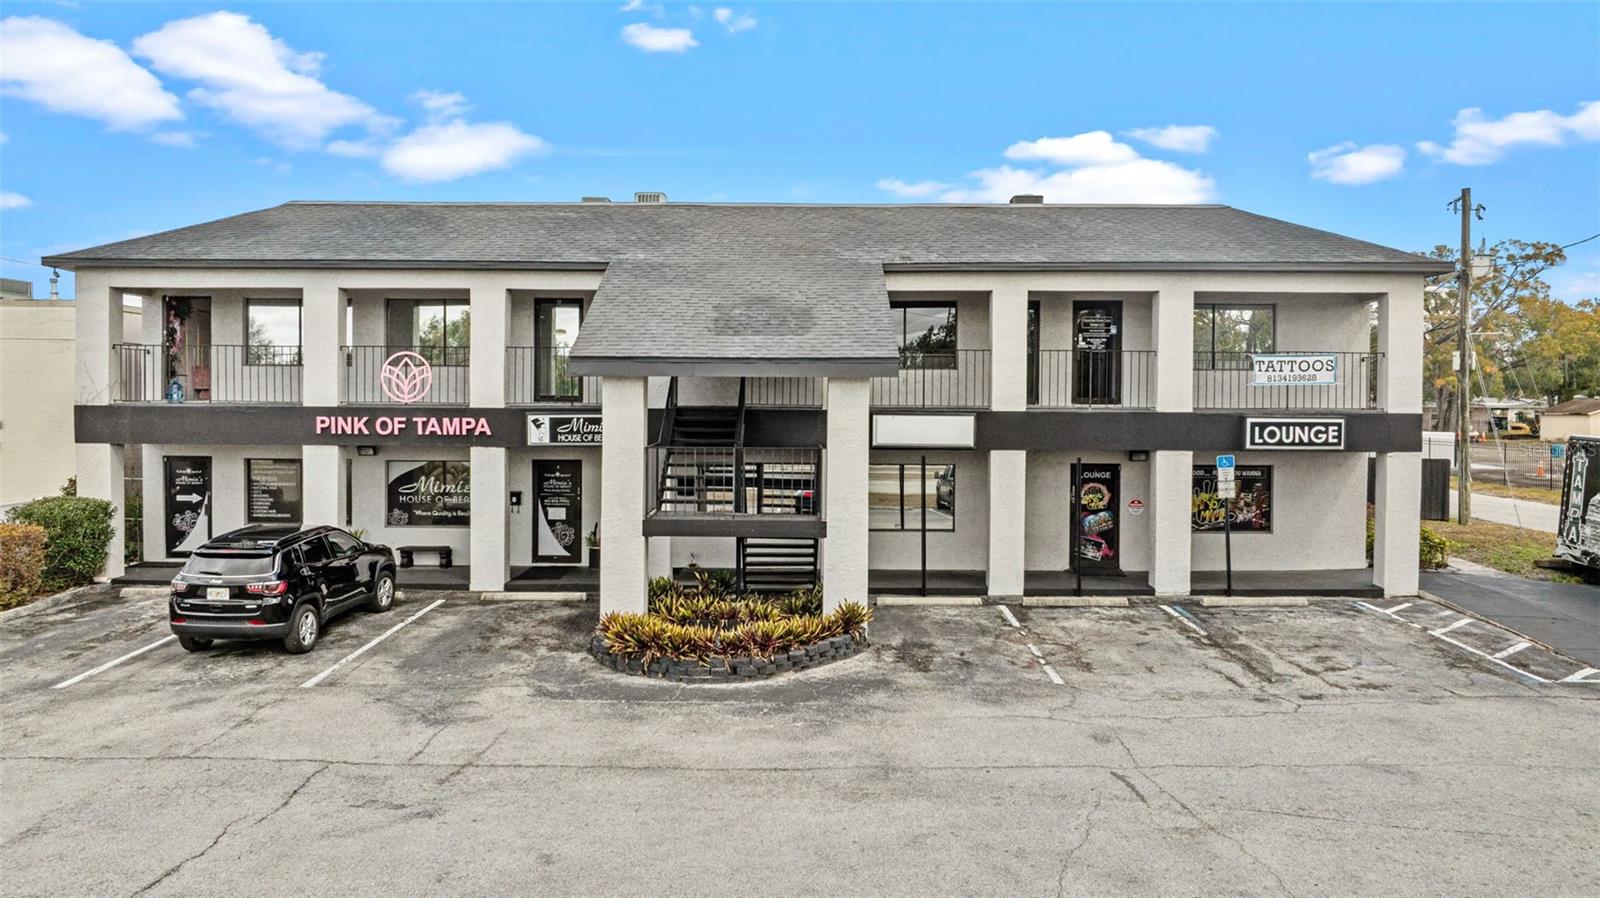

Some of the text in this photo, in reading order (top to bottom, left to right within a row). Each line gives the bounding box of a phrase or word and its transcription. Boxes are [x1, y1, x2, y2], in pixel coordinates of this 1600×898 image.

[1255, 360, 1335, 372] TATTOOS
[1267, 374, 1317, 382] 8134193628
[315, 416, 492, 435] PINK OF TAMPA
[1254, 425, 1339, 443] LOUNGE
[400, 495, 432, 503] HOUSE
[435, 495, 449, 503] OF
[1567, 458, 1586, 543] TAMPA
